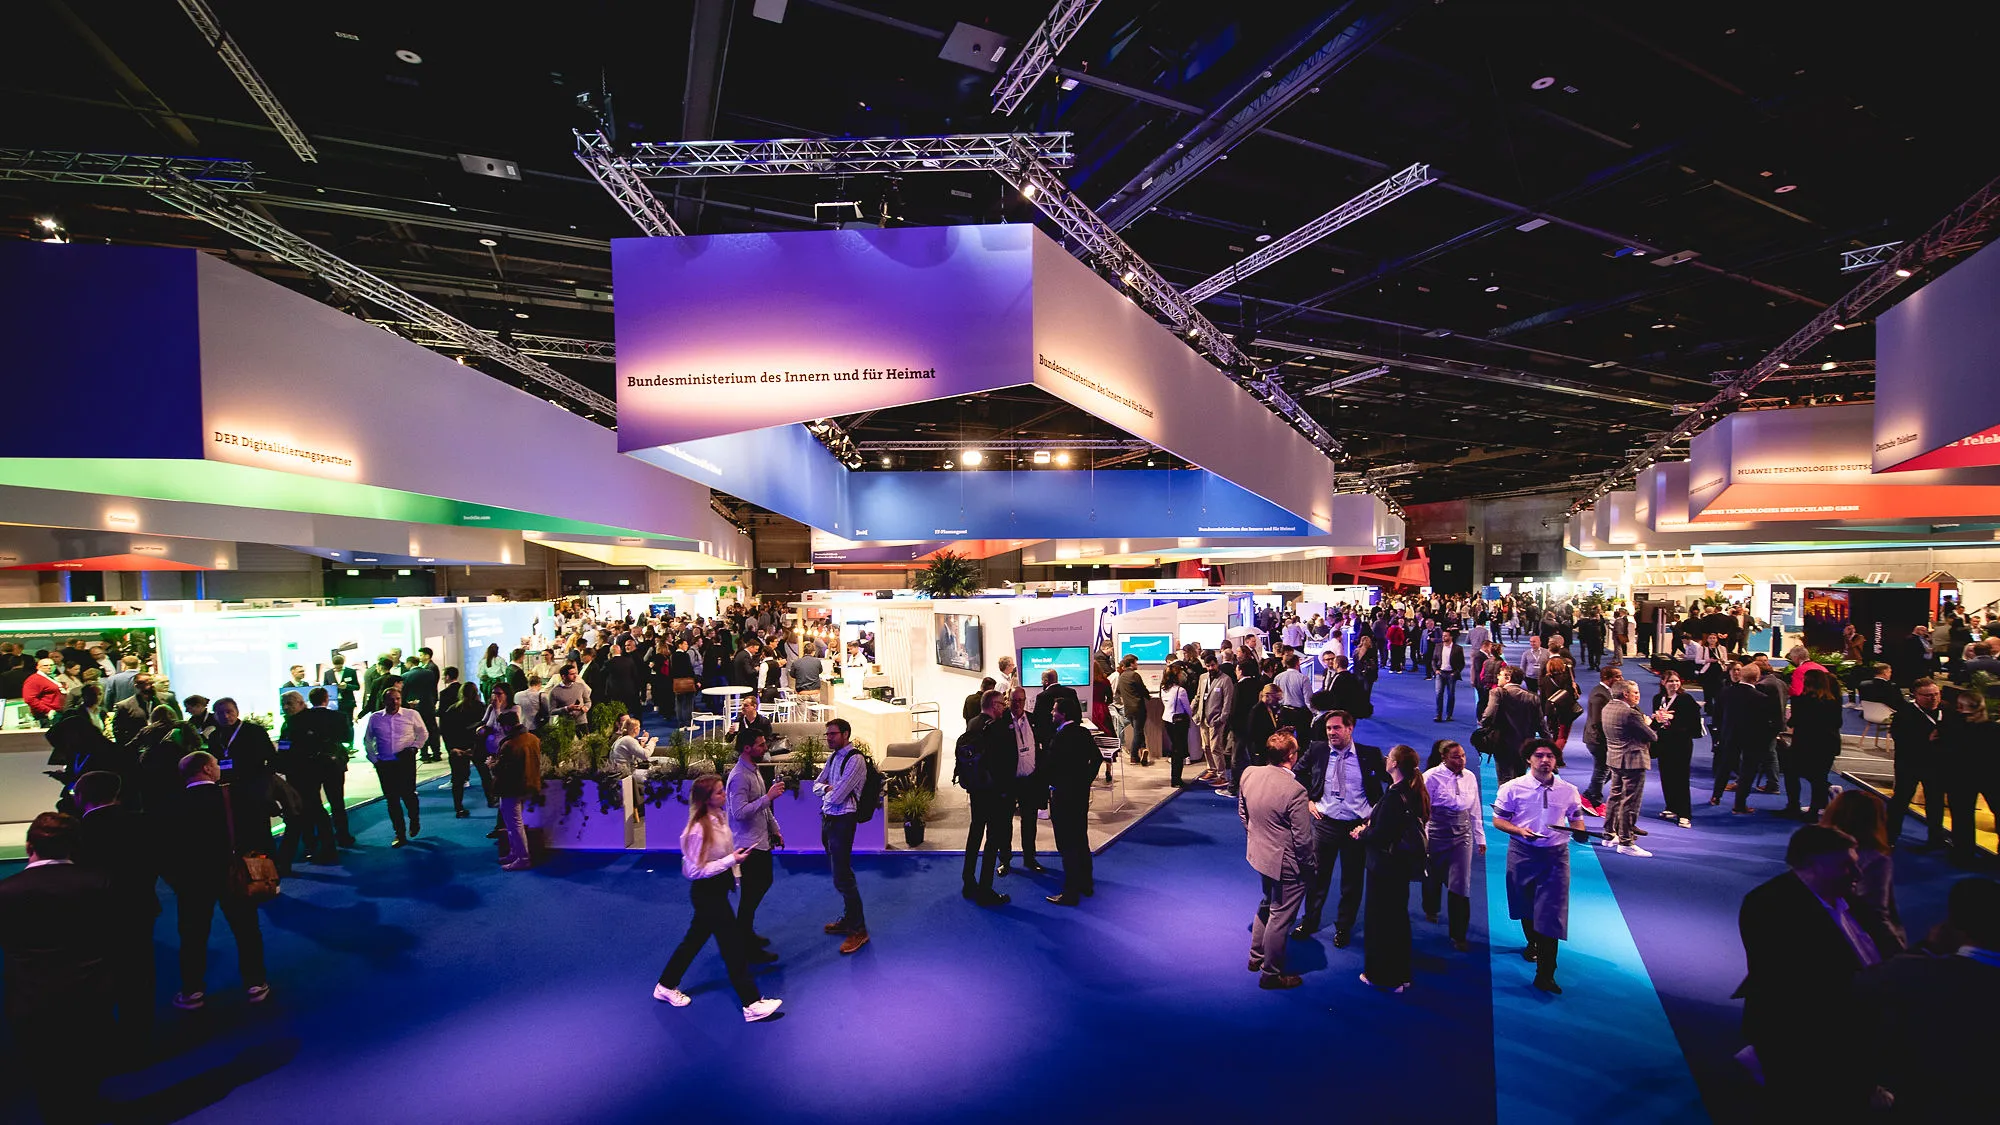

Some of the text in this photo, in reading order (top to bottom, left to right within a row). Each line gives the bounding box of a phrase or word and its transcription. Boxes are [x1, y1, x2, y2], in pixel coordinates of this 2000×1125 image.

[627, 367, 936, 387] Bundesministerium des Innern und für Heimat
[1039, 353, 1096, 390] Bundesministerium
[214, 432, 352, 466] DER Digitalisierungspartner
[1876, 434, 1918, 452] Deutsche Telekom
[1738, 467, 1772, 475] HUAWEI
[1773, 465, 1838, 474] TECHNOLOGIES
